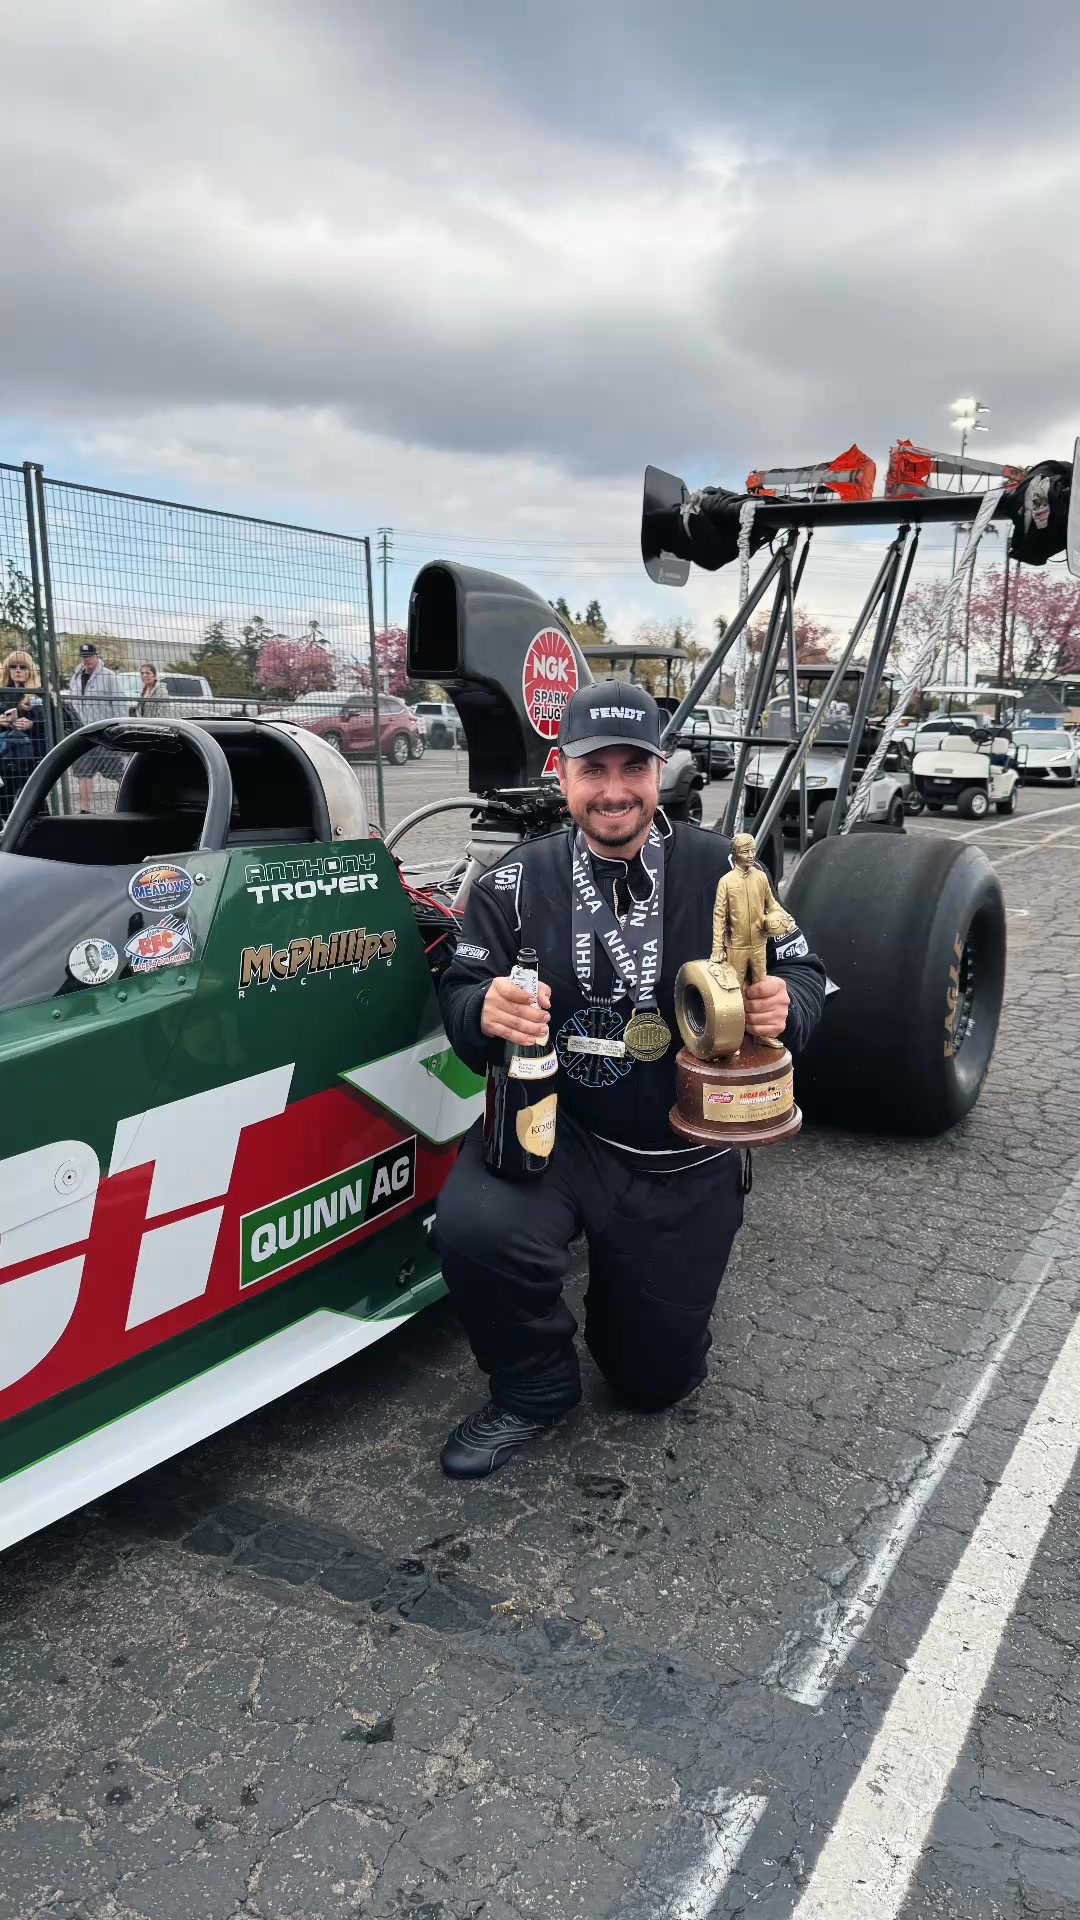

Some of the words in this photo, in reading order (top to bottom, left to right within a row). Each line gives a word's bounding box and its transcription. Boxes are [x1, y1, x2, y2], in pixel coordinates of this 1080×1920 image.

[533, 654, 569, 683] NGK
[534, 689, 568, 706] SPARK
[589, 706, 646, 722] FENDT
[245, 853, 376, 884] ANTHONY
[133, 878, 192, 899] MEADOWS
[247, 873, 379, 905] TROYER
[573, 859, 603, 915] NHRA
[138, 930, 174, 956] RFC
[238, 927, 397, 990] McPhillips
[604, 928, 638, 989] NHRA
[238, 960, 393, 999] RACING
[638, 938, 658, 1001] NHRA
[251, 1178, 363, 1263] QUINN
[371, 1155, 410, 1204] AG
